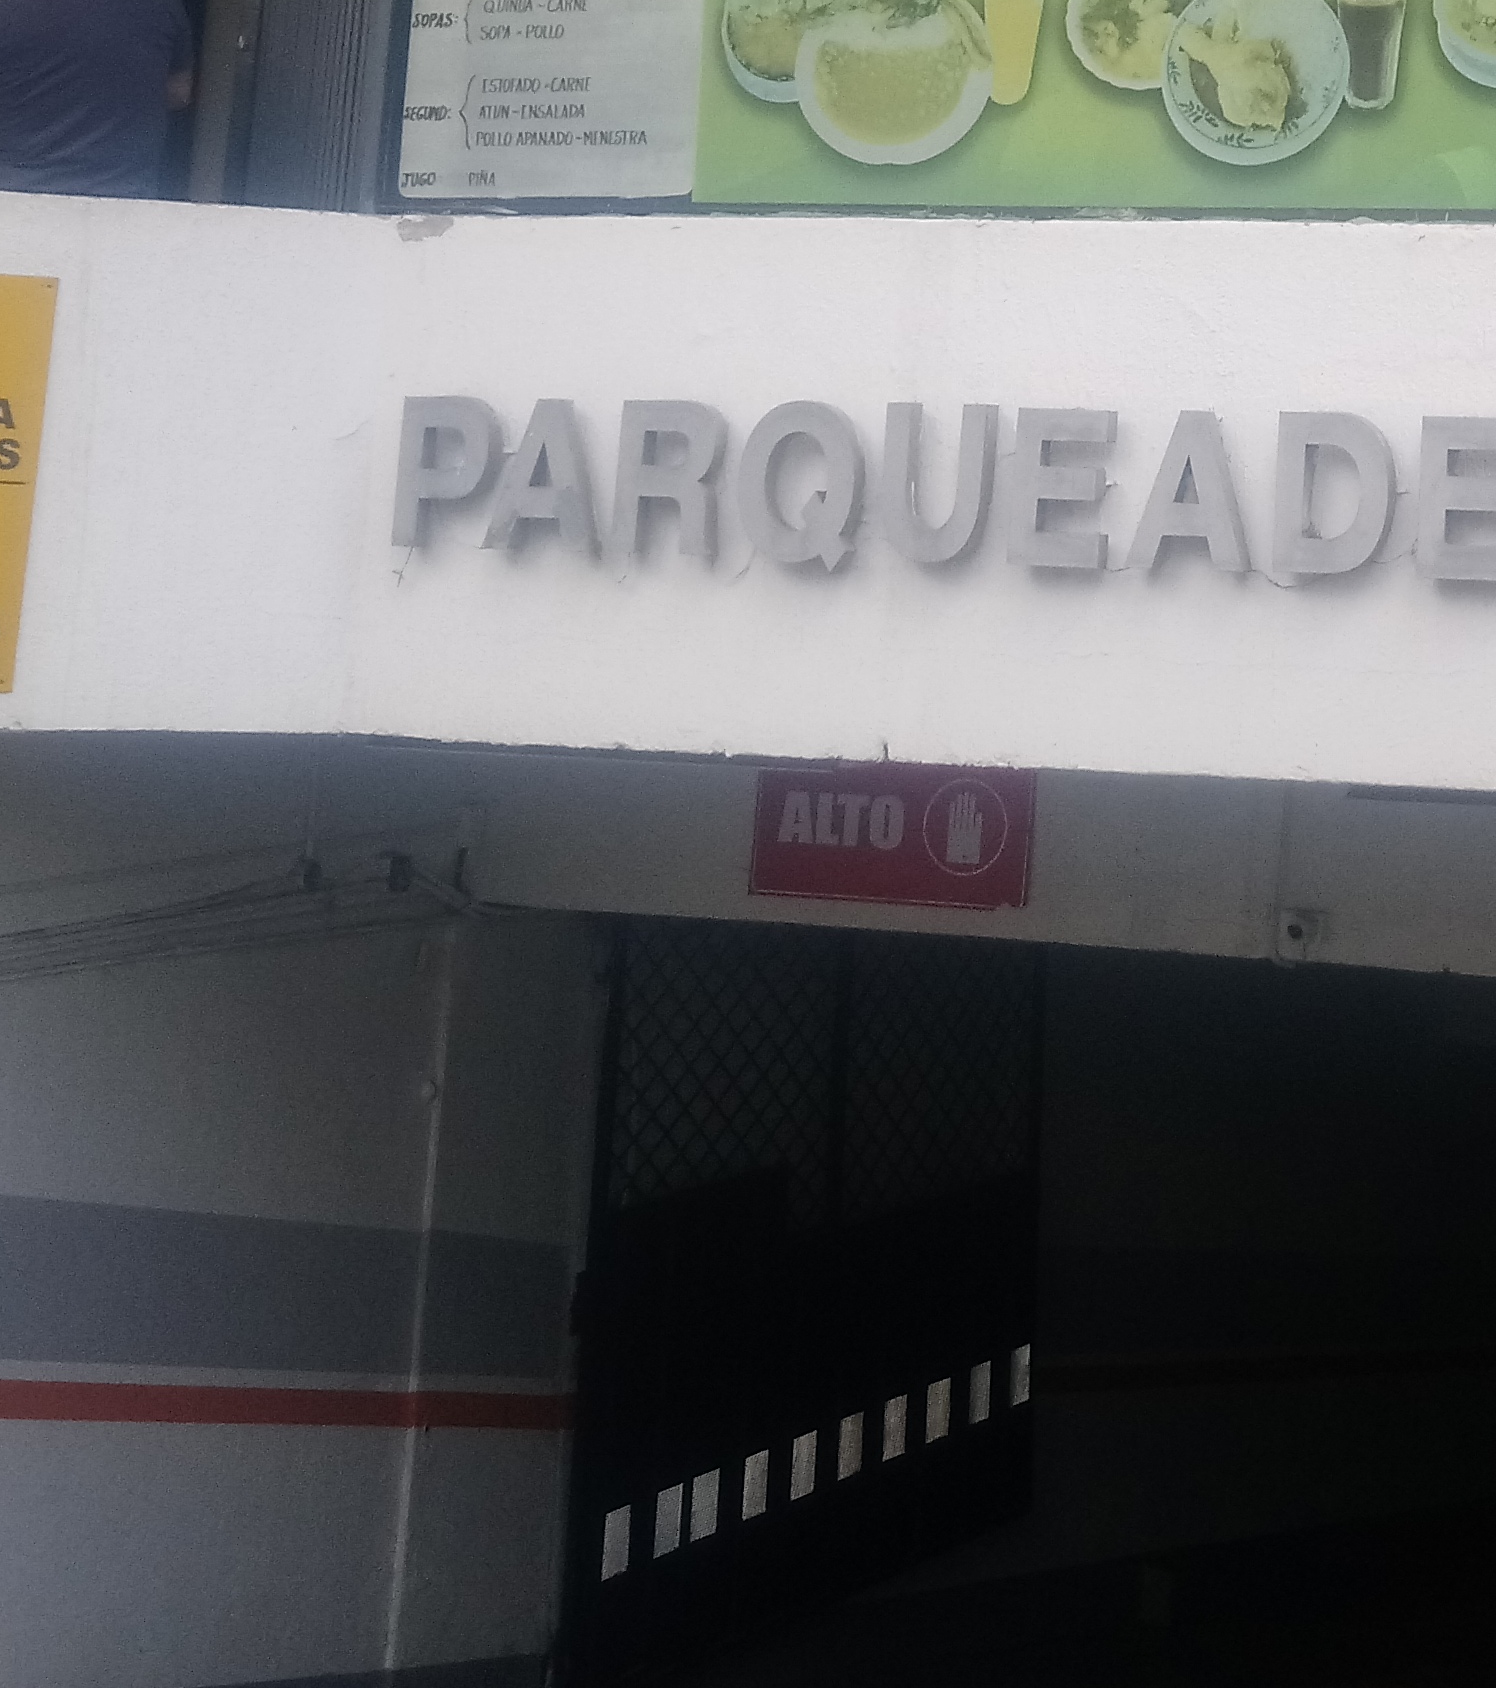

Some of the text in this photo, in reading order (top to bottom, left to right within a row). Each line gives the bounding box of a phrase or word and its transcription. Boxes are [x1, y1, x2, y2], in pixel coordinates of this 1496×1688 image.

[412, 13, 459, 29] SOPAS:
[401, 172, 436, 187] JUGO
[776, 791, 905, 850] ALTO
